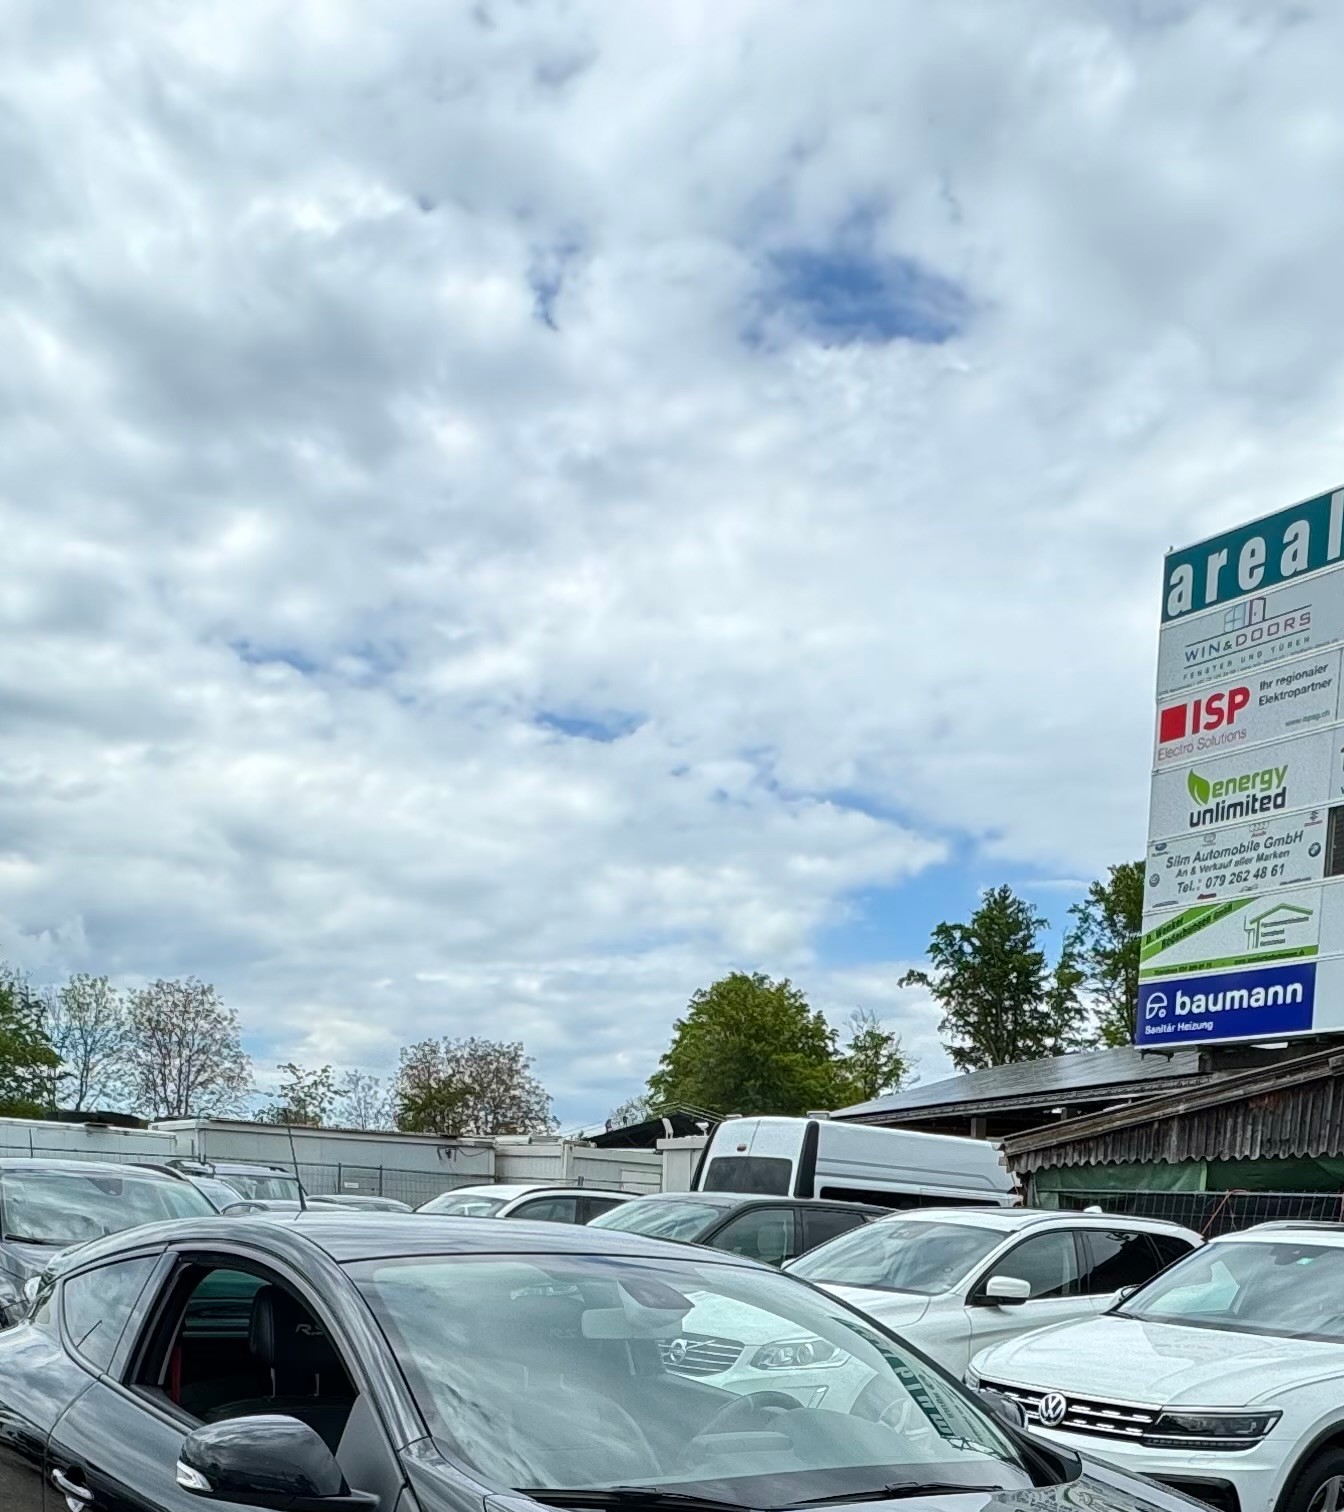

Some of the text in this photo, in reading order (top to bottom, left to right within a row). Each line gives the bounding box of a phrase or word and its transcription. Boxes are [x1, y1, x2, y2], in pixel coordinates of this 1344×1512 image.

[1258, 677, 1333, 706] Elektropartner
[1259, 664, 1329, 691] Ihr regionaler
[1191, 686, 1251, 735] ISP
[1157, 728, 1247, 761] Electro Solutions
[1211, 764, 1289, 799] energy
[1189, 786, 1287, 828] unlimited
[1192, 838, 1261, 864] Automobile
[1263, 829, 1304, 849] GmbH
[1175, 868, 1188, 879] An
[1189, 865, 1197, 876] &
[1199, 858, 1233, 874] Verkauf
[1255, 849, 1291, 864] Marken
[1205, 874, 1227, 890] 079
[1228, 869, 1251, 886] 262
[1252, 866, 1268, 881] 48
[1270, 862, 1286, 877] 61
[1174, 981, 1304, 1016] baumann
[1176, 1020, 1215, 1032] Heizung
